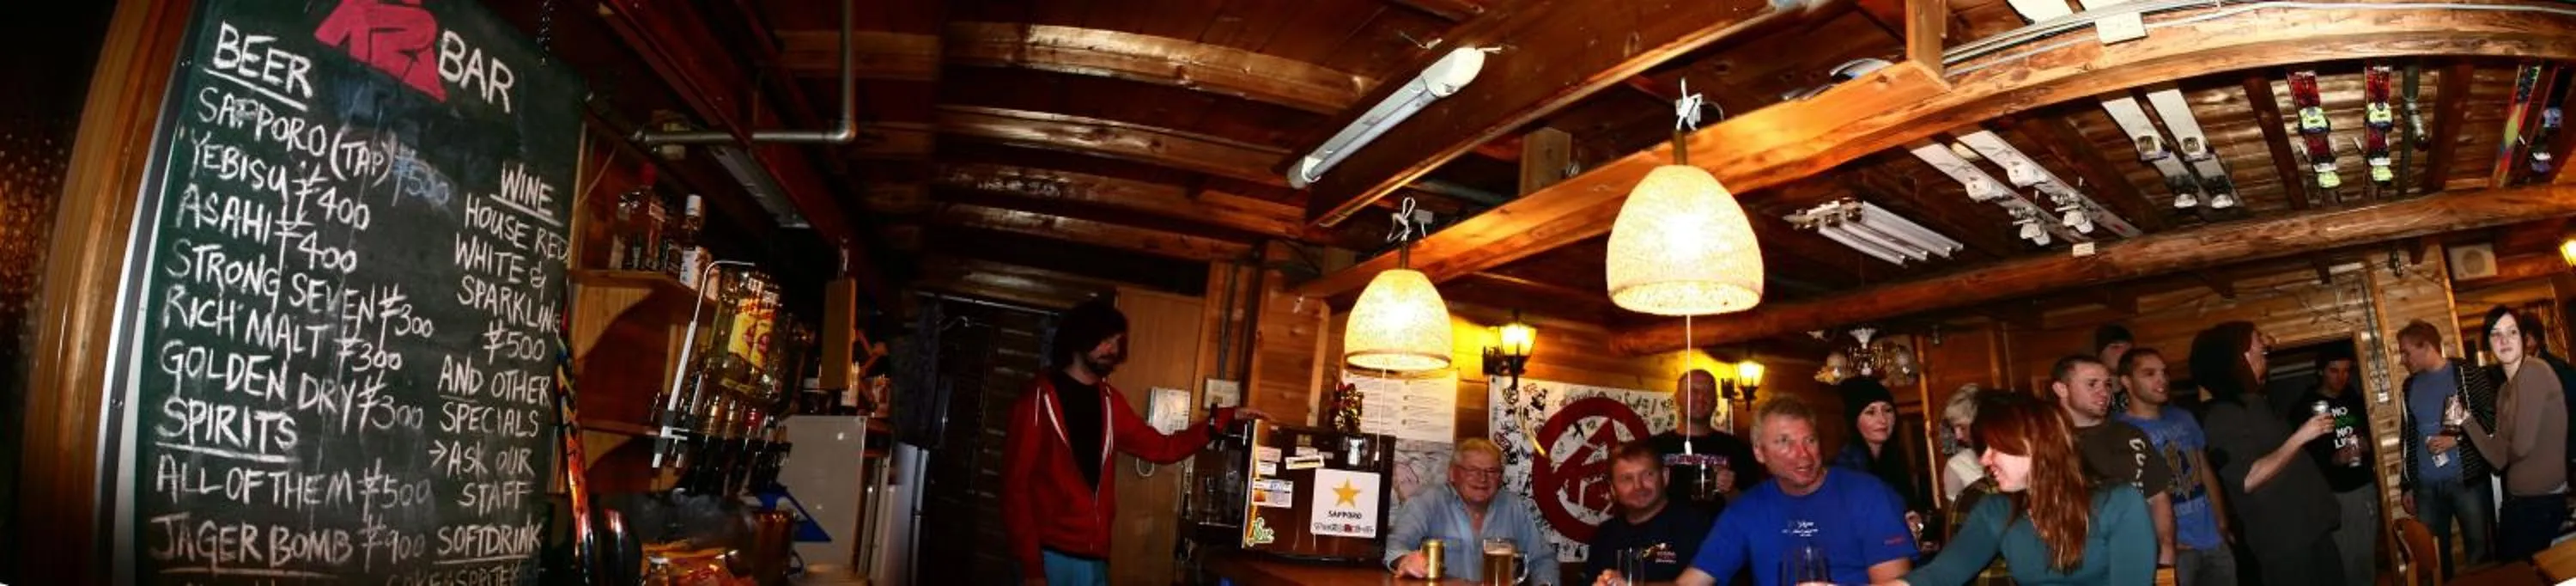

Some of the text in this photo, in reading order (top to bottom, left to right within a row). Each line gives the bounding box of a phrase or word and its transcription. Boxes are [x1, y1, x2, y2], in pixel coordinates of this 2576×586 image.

[213, 21, 313, 98] BEER
[438, 29, 514, 113] BAR
[198, 87, 326, 156] SAPPORO
[191, 129, 289, 202] YEBISU
[501, 162, 555, 216] WINE
[176, 183, 271, 245] ASAHI
[465, 192, 531, 250] HOUSE
[166, 238, 280, 312] STRONG
[289, 272, 375, 323] SEVEN
[454, 231, 526, 284] WHITE
[163, 284, 234, 341] RICH
[246, 308, 334, 360] MALT
[457, 274, 562, 338] SPARKLING
[161, 339, 288, 401] GOLDEN
[298, 372, 355, 433] DRY
[438, 354, 551, 408] AND OTHER
[155, 397, 298, 454] SPIRITS
[440, 401, 539, 437] SPECIALS
[156, 454, 223, 504] ALL
[226, 467, 264, 504] OF
[268, 468, 353, 511] THEM
[447, 440, 535, 478] ASK OUR
[458, 482, 534, 517] STAFF
[150, 512, 262, 567] JAGER
[270, 523, 353, 567] BOMB
